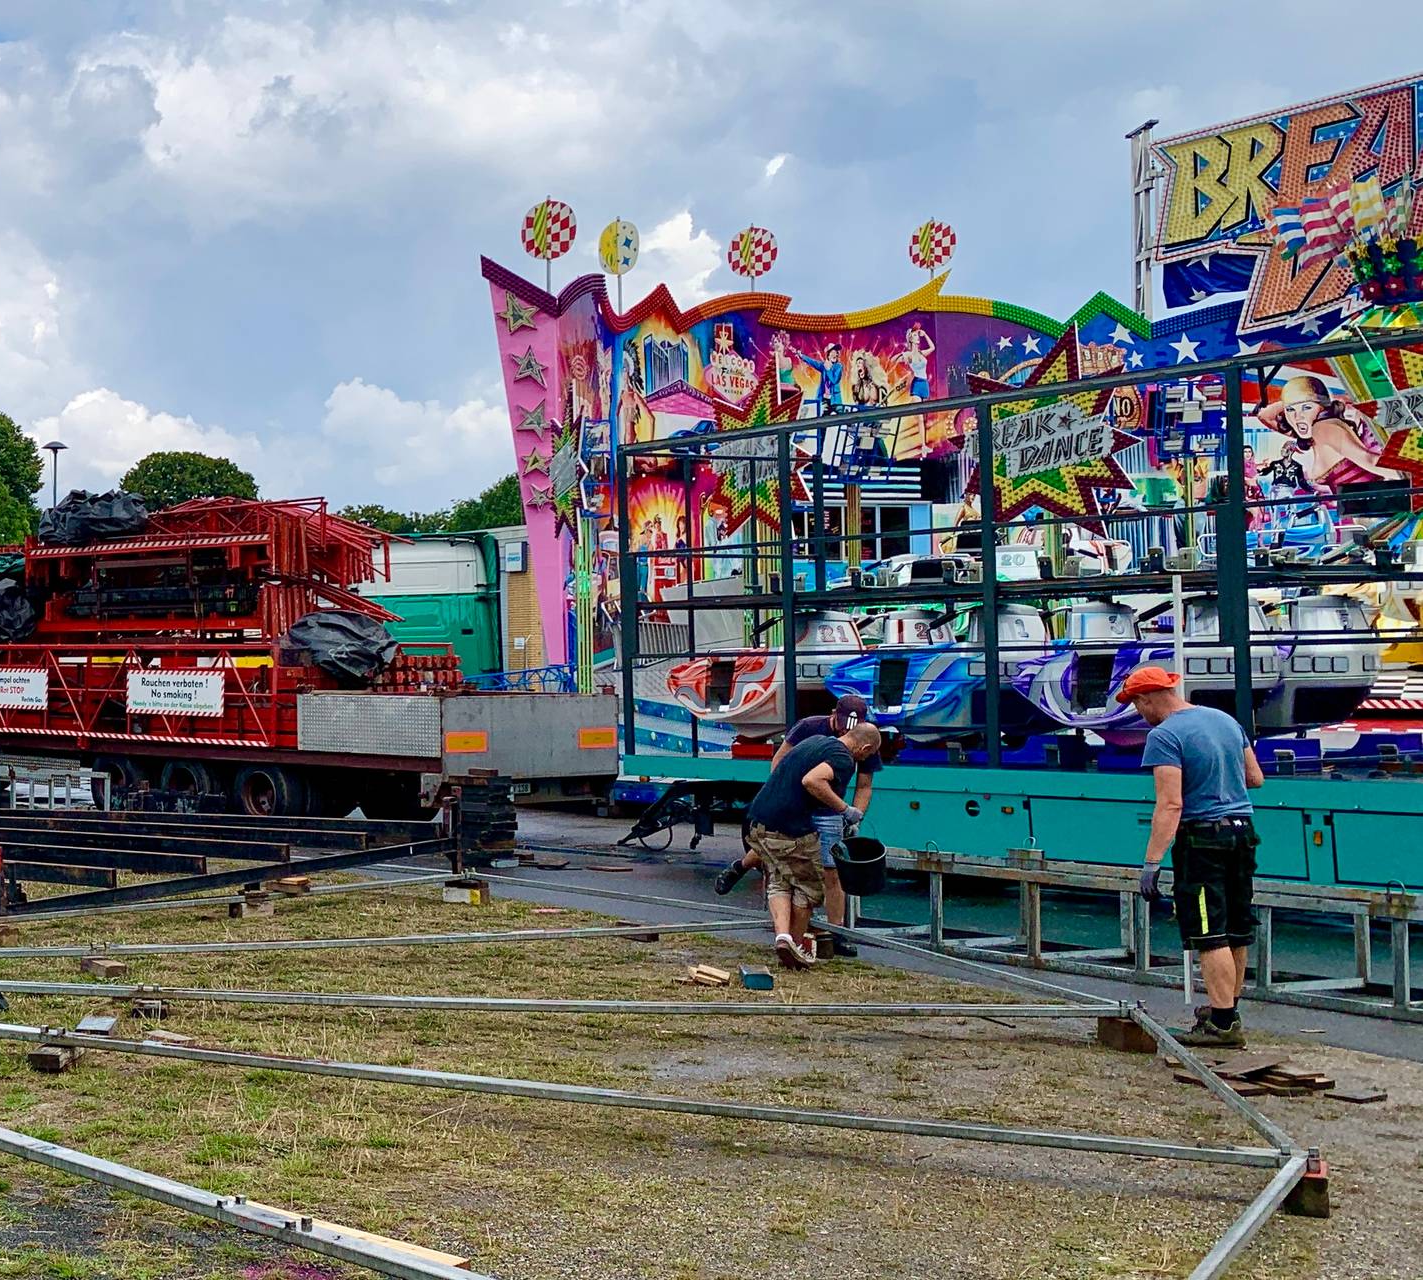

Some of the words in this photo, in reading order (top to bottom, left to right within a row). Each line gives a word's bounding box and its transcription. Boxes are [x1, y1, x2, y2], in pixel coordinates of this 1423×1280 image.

[711, 374, 727, 388] LAS
[729, 375, 754, 392] VEGAS
[1018, 425, 1104, 472] DANCE
[818, 624, 849, 643] 21
[12, 676, 31, 684] achten
[141, 677, 171, 687] Rauchen
[172, 678, 204, 688] verboten
[9, 686, 25, 694] STOP
[151, 689, 162, 698] No
[163, 690, 193, 701] smoking
